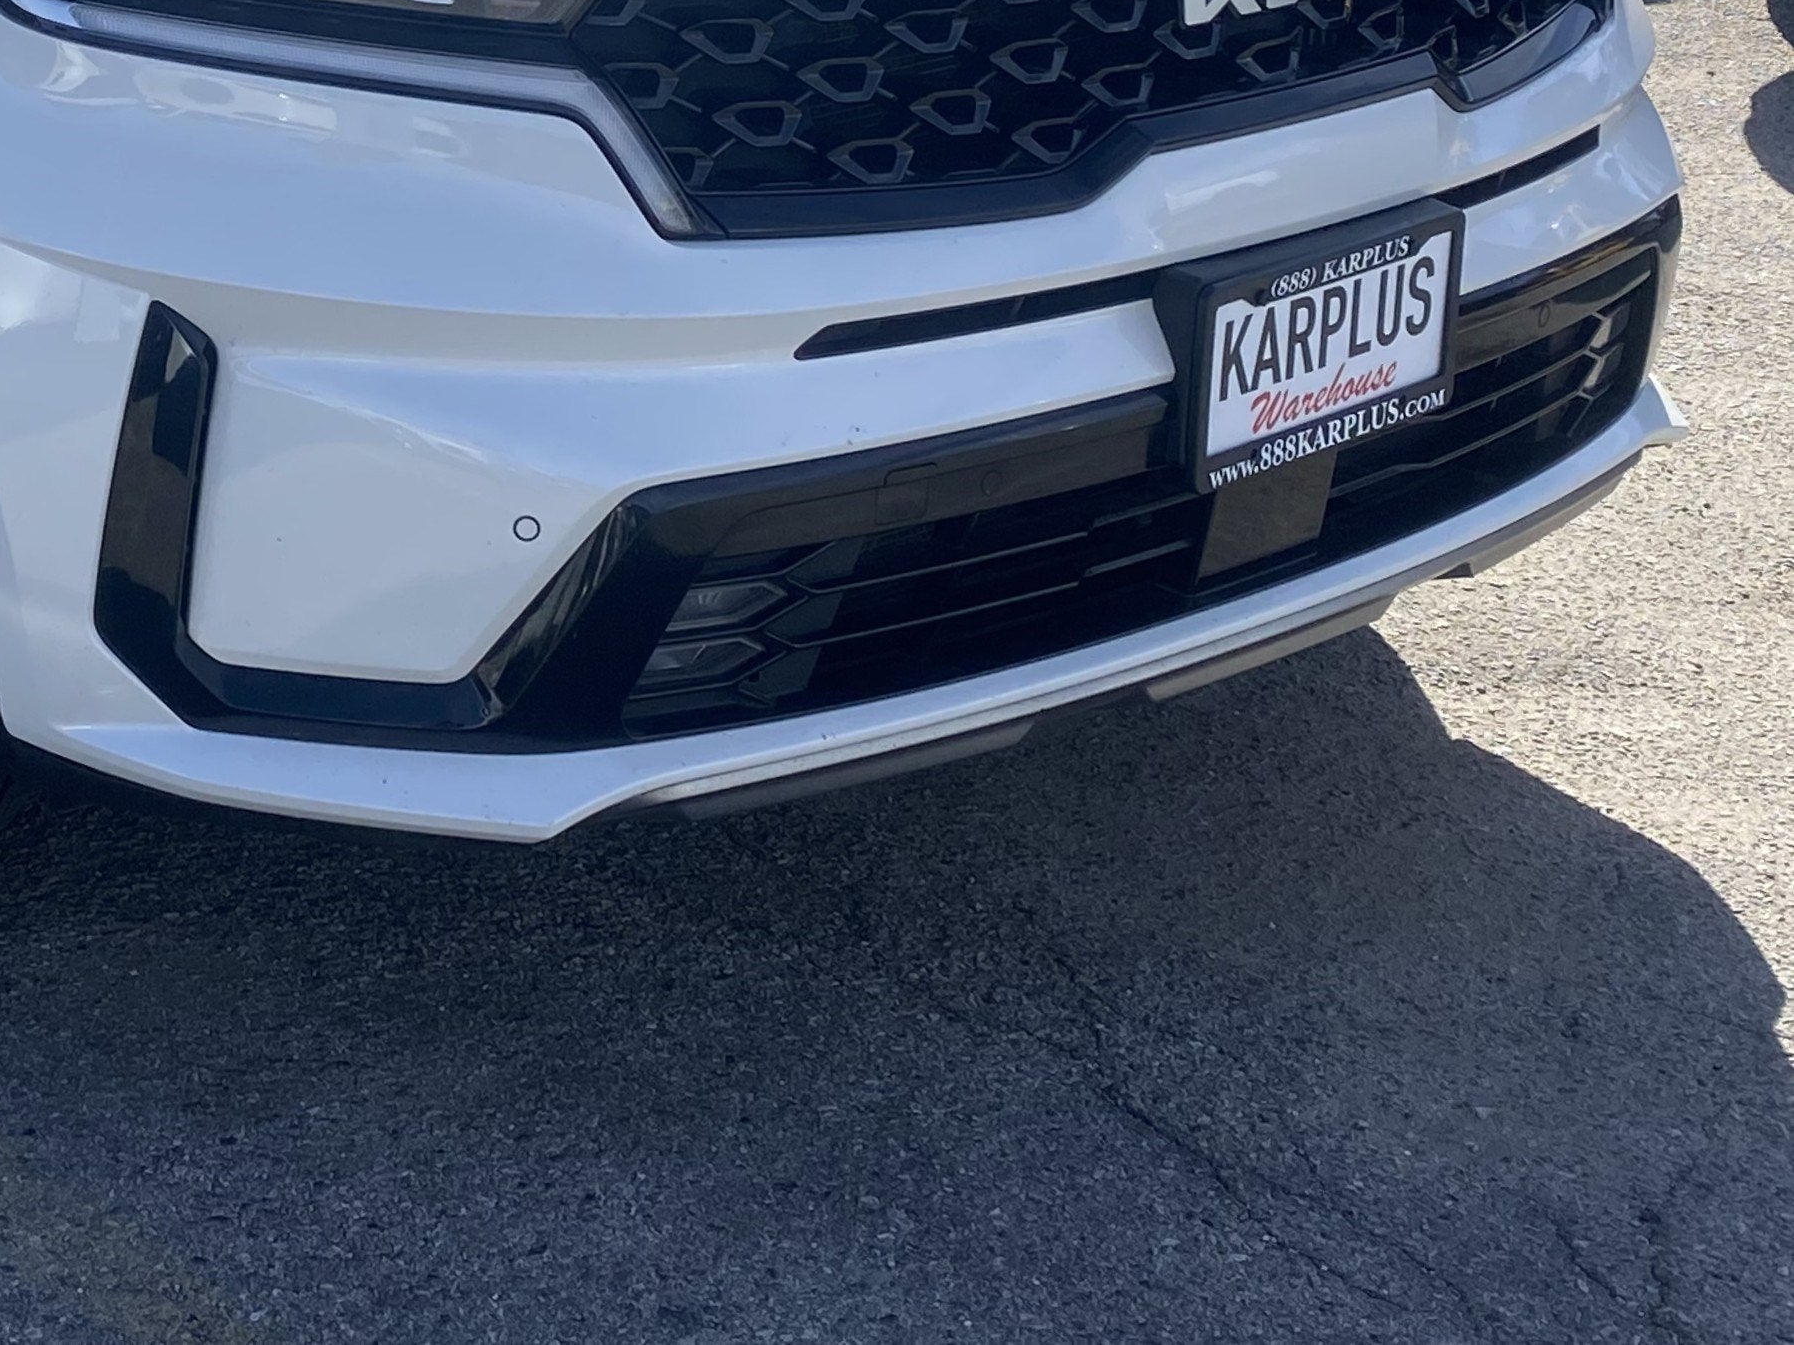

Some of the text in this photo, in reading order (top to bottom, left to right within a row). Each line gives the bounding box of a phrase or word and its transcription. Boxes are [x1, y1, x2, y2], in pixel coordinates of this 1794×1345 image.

[1270, 234, 1412, 298] (888) KARPLUS
[1218, 255, 1436, 403] KARPLUS
[1250, 360, 1399, 435] Warehouse
